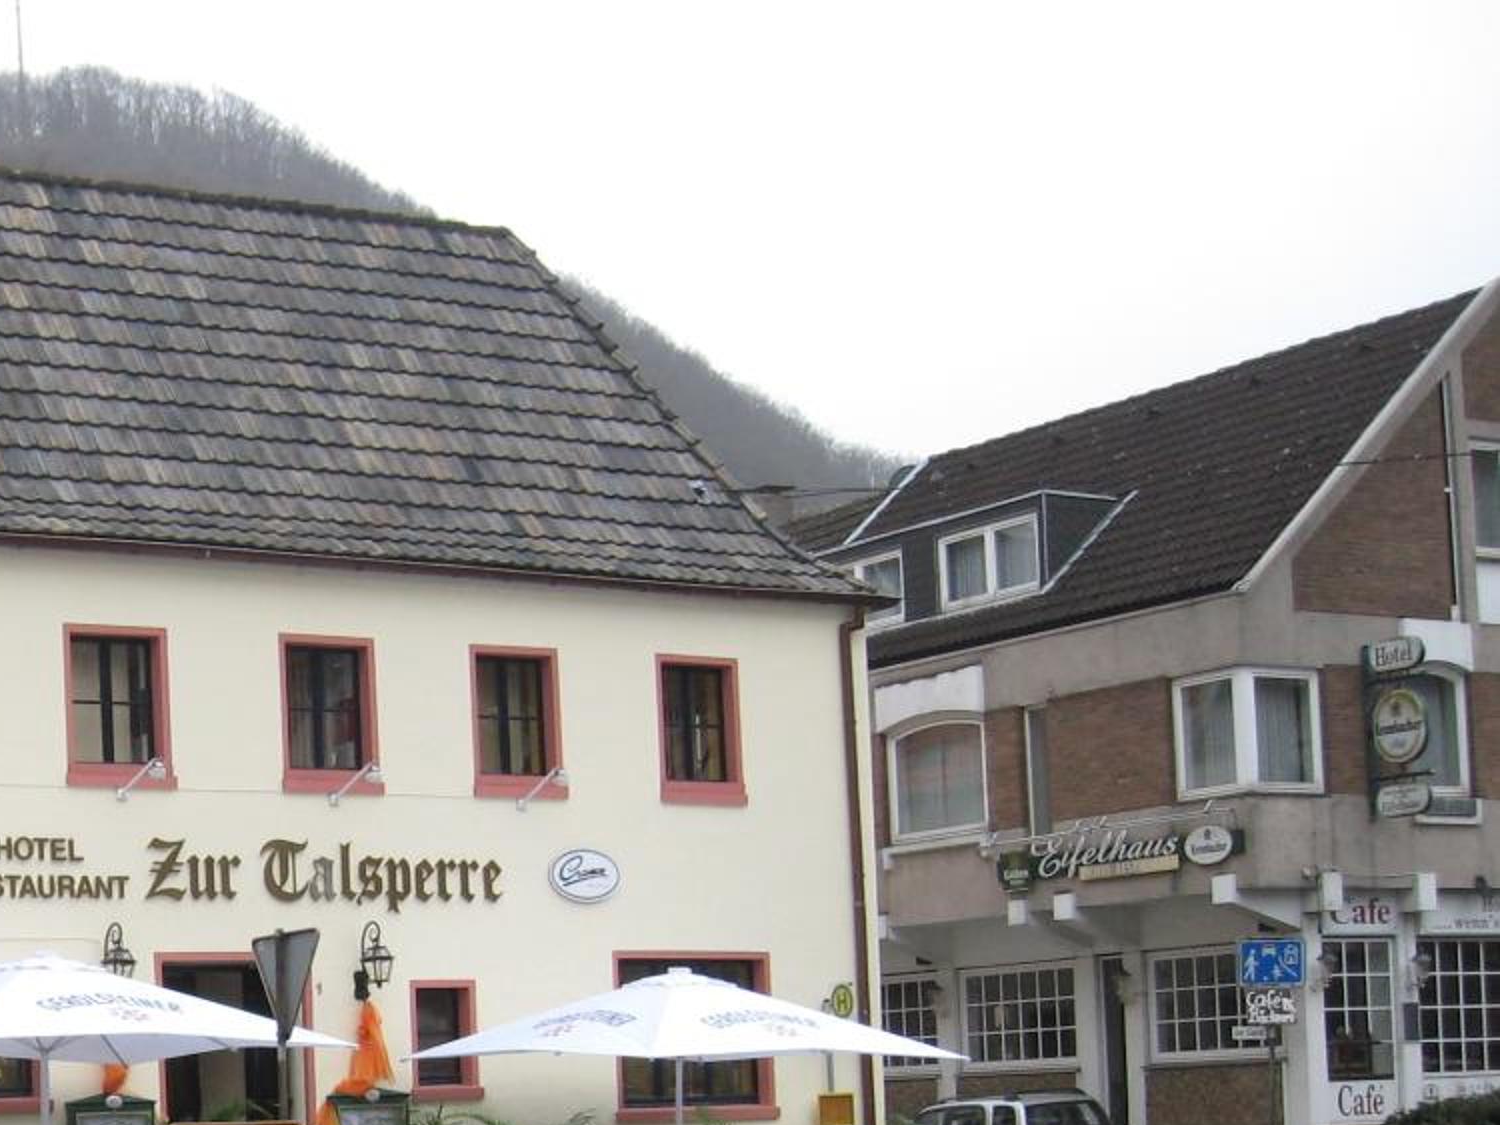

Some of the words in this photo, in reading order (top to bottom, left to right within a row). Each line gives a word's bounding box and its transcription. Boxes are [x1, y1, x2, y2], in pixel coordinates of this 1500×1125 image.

[1376, 640, 1412, 667] Hotel
[145, 837, 242, 901] Zur
[259, 838, 503, 914] Talsperre
[1031, 829, 1179, 880] Eifelhaus
[1337, 1083, 1385, 1117] Café
